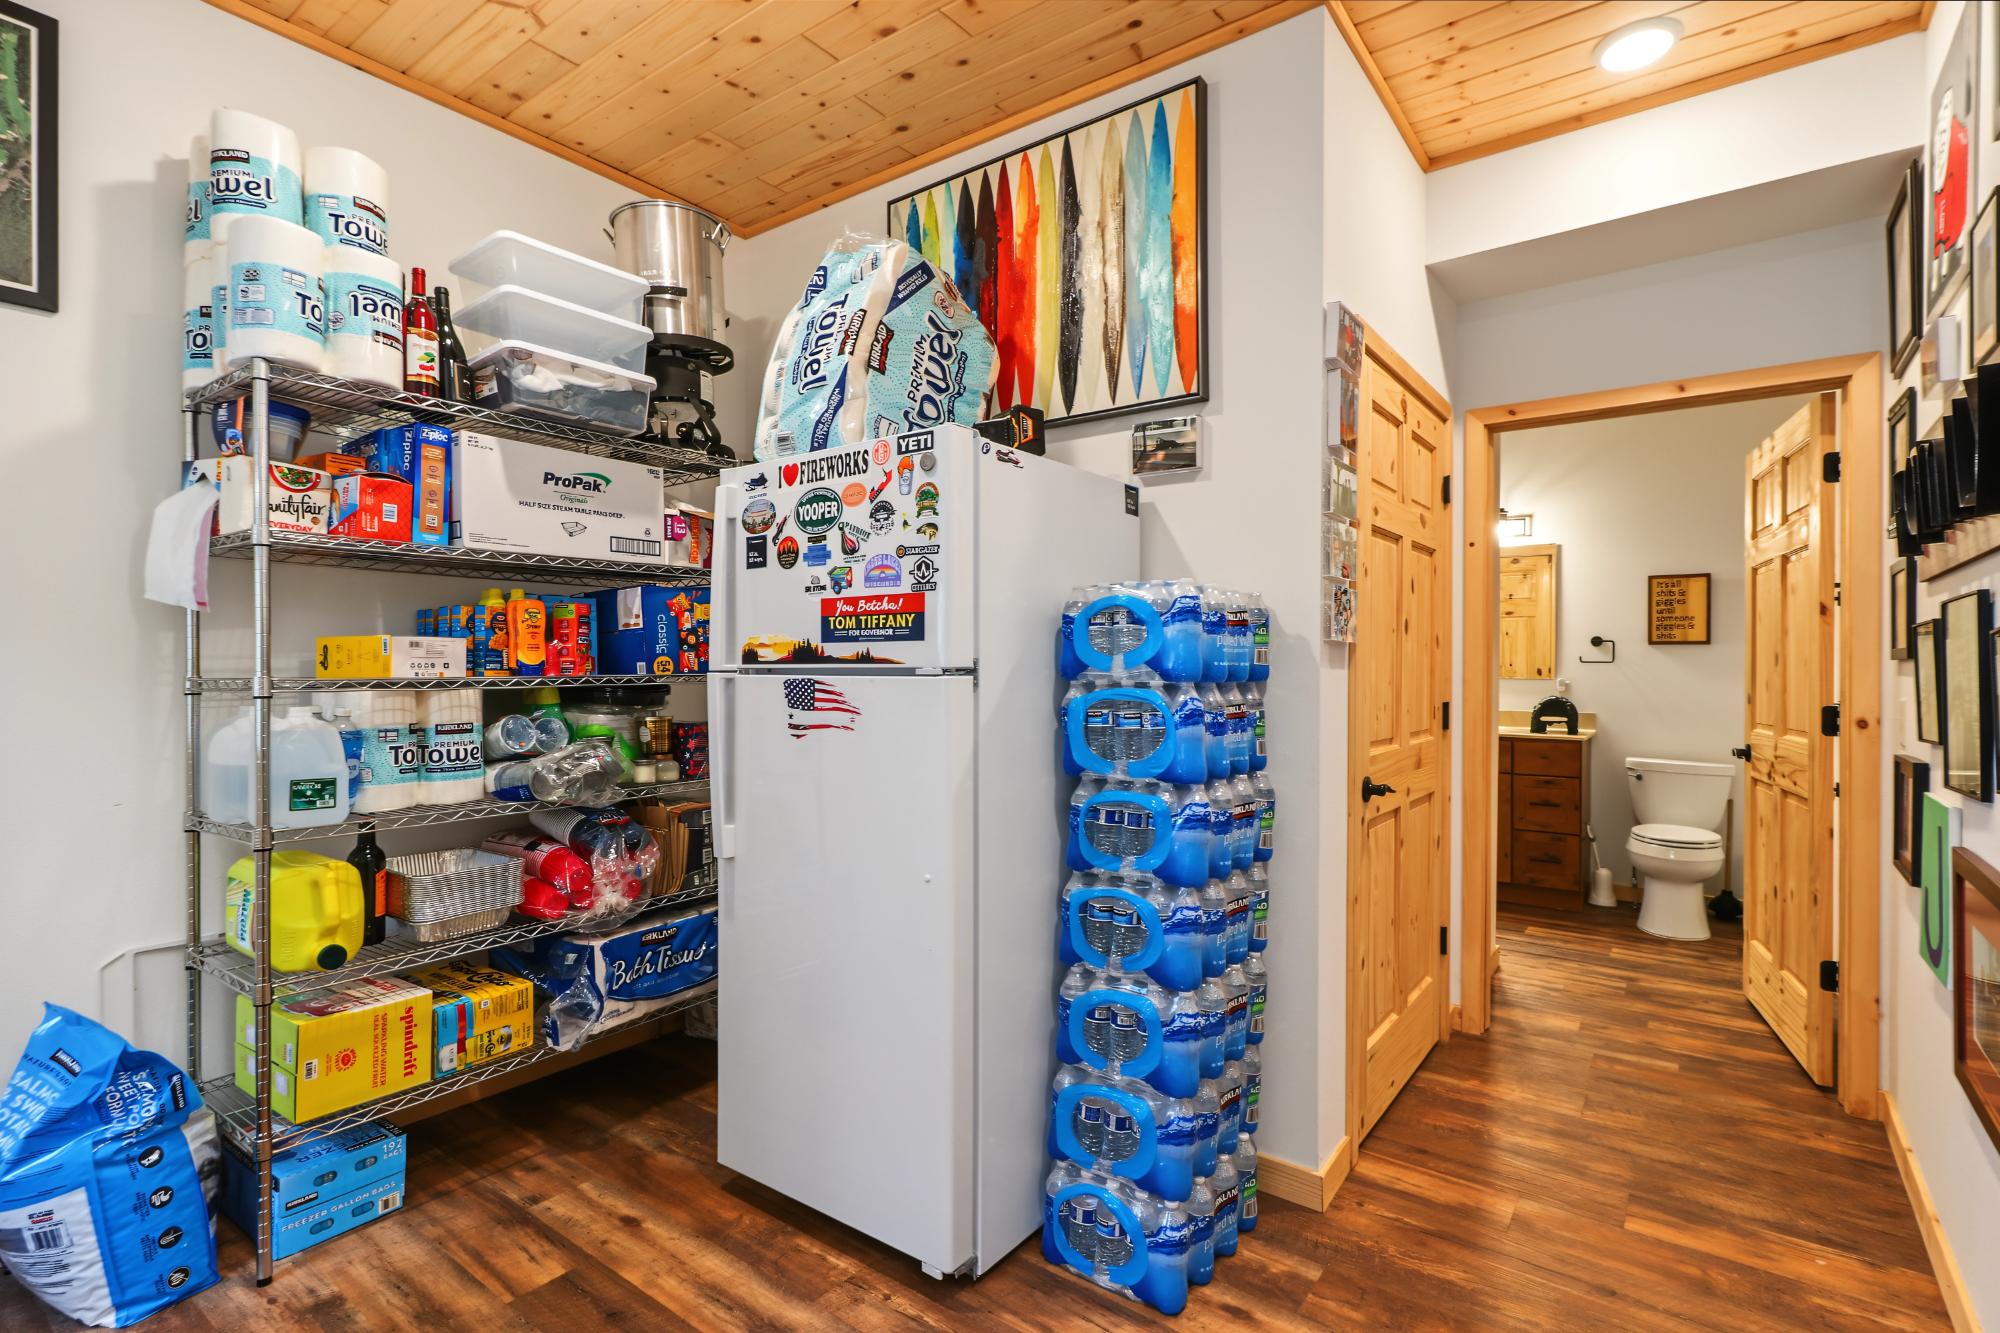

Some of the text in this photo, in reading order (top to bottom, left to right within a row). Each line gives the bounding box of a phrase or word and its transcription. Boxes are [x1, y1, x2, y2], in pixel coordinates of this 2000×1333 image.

[421, 428, 449, 442] Ziploc
[899, 434, 933, 451] YETI
[402, 430, 414, 471] Ziploc
[778, 466, 782, 488] I
[800, 449, 869, 485] FIREWORKS
[542, 471, 603, 493] ProPak
[268, 494, 300, 522] anity
[518, 500, 537, 508] HALF
[551, 504, 574, 513] STEAM
[798, 501, 838, 521] YOOPER
[836, 596, 904, 616] You Betcha!
[828, 613, 916, 630] TOM TIFFANY
[657, 614, 669, 654] classic
[860, 628, 894, 636] GOVERNOR
[660, 660, 671, 673] 54
[434, 740, 475, 748] PREMIUM
[612, 950, 656, 990] Bath
[399, 1006, 418, 1079] spindrift
[281, 1211, 328, 1232] FREEZER
